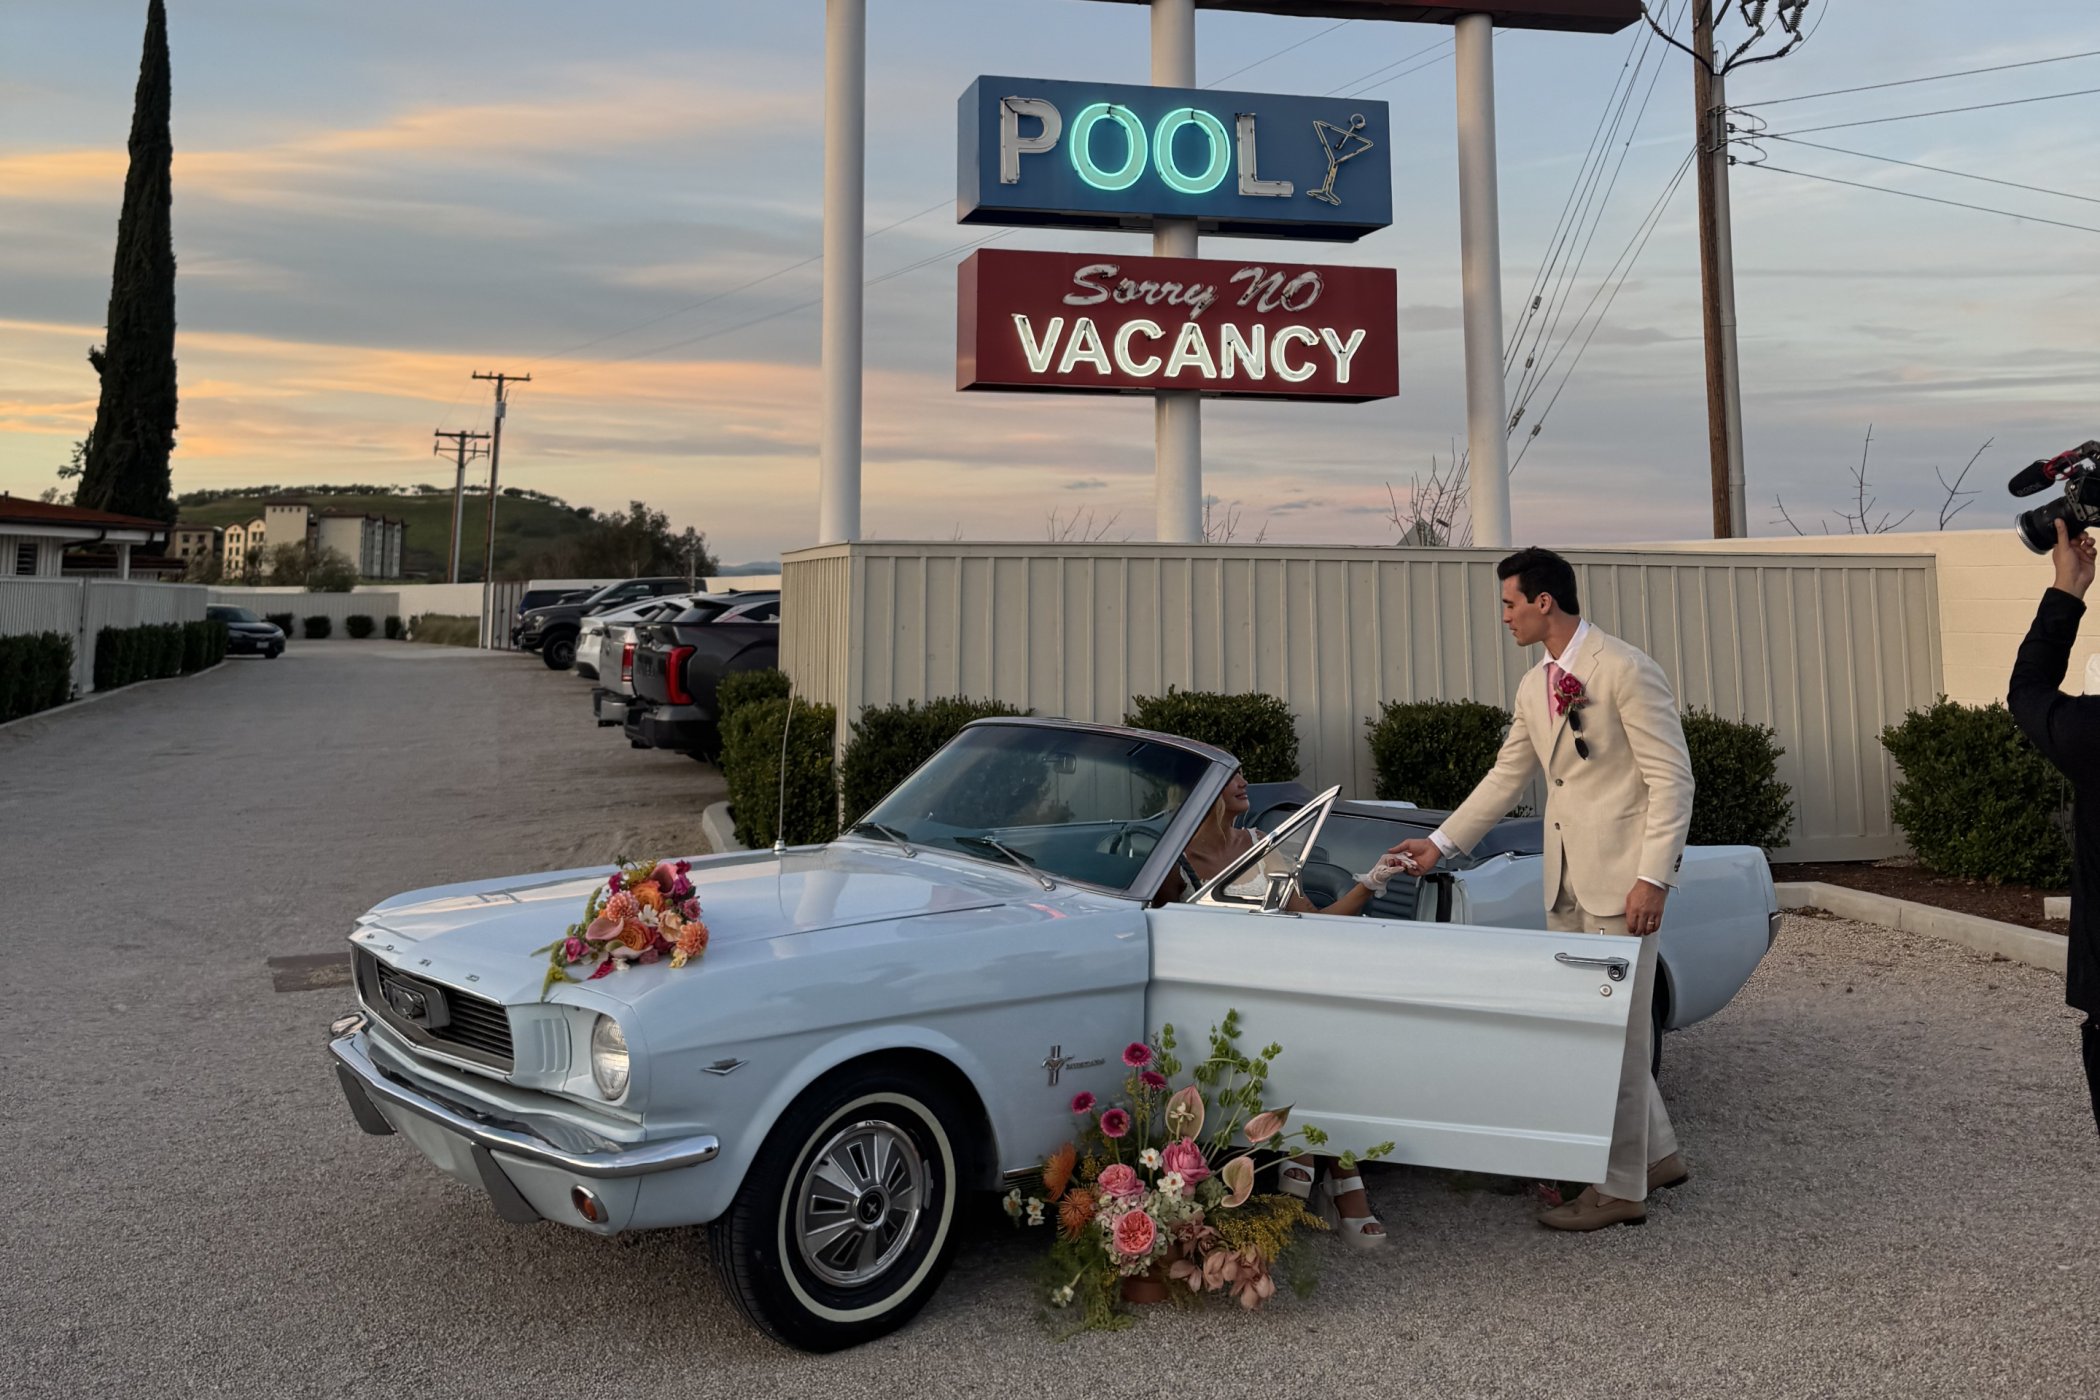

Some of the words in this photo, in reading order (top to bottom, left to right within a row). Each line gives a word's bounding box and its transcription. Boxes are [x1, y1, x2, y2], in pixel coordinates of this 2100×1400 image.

[1000, 95, 1294, 197] POOL
[1063, 263, 1220, 320] Sorry
[1230, 266, 1325, 313] NO
[1011, 313, 1367, 384] VACANCY
